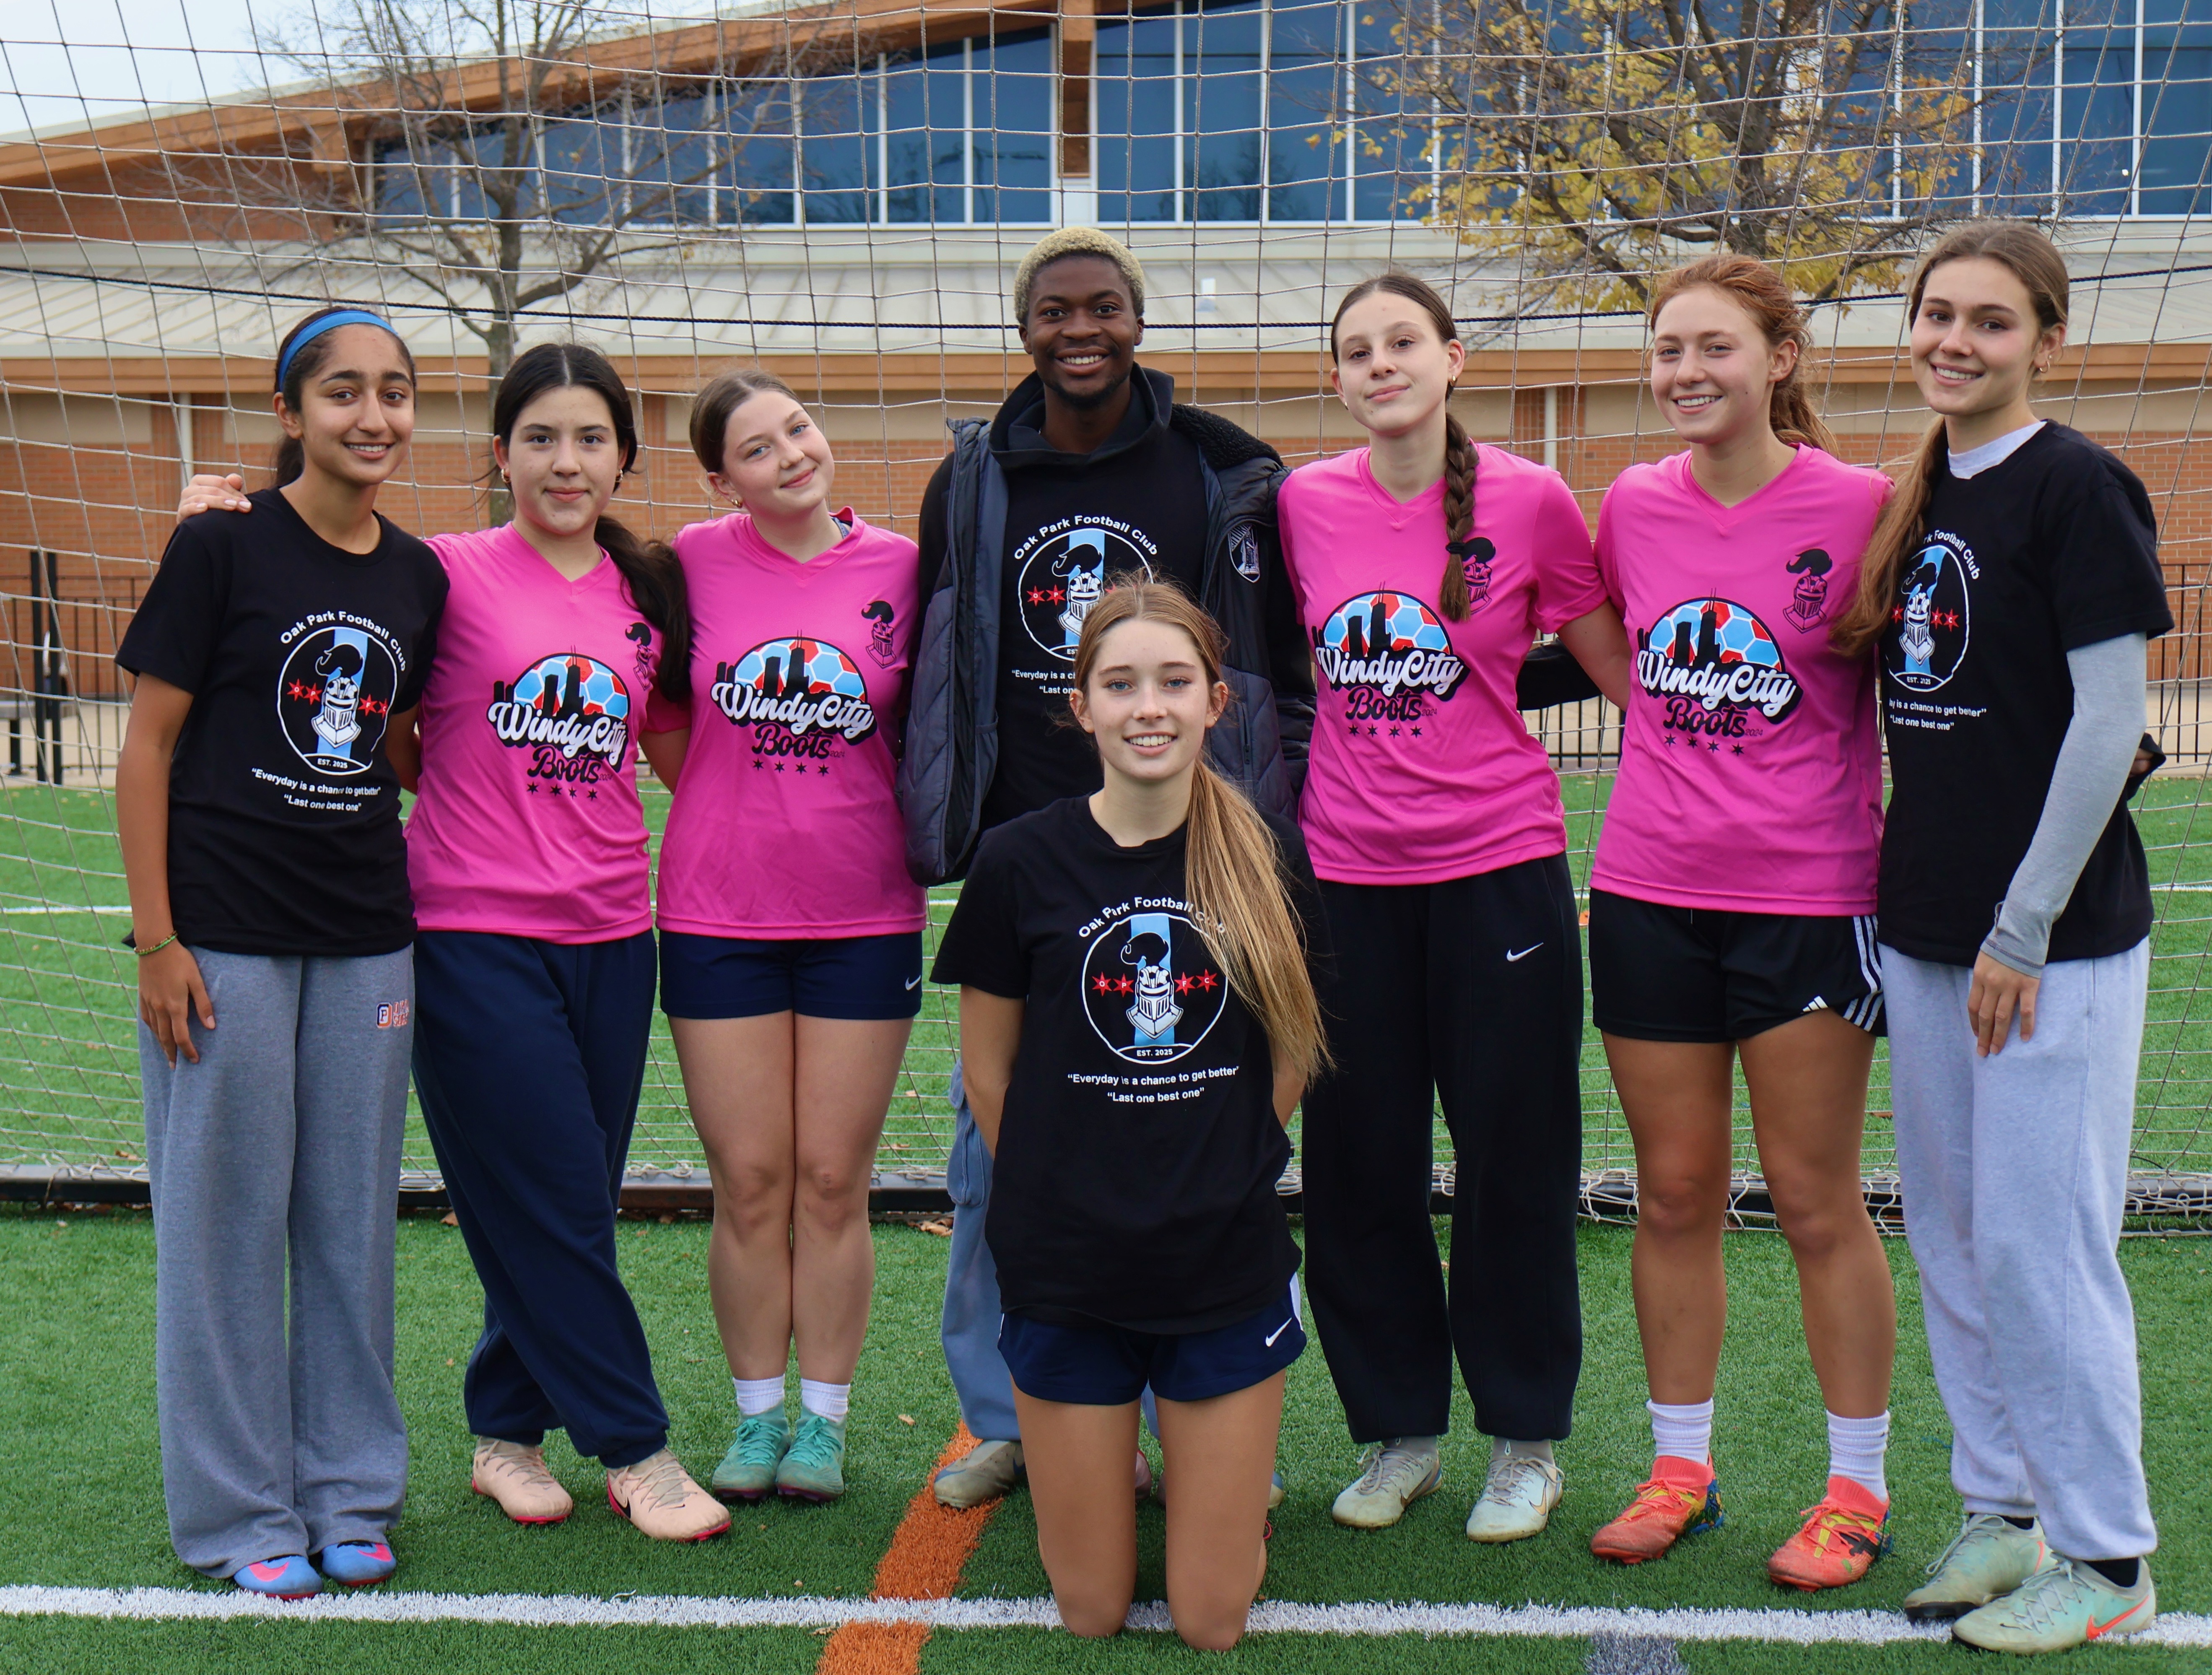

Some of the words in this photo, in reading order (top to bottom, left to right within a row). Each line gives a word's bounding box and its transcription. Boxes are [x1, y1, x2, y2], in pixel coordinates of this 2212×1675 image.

[1014, 535, 1038, 560] Oak
[1039, 518, 1071, 537] Park
[1075, 515, 1130, 533] Football
[1132, 529, 1158, 556] Club
[1923, 534, 1933, 544] rk
[1934, 530, 1966, 552] Football
[1963, 549, 1981, 580] Club
[280, 621, 306, 644] Oak
[306, 610, 335, 626] Park
[338, 610, 389, 640] Football
[390, 638, 406, 671] Club
[1012, 670, 1048, 680] “Everyday
[1039, 685, 1061, 694] “Last
[1346, 686, 1423, 722] Boots
[1663, 696, 1748, 738] Boots
[1896, 699, 1902, 709] is
[1910, 701, 1934, 713] chance
[1935, 705, 1942, 714] to
[1944, 706, 1957, 716] get
[1921, 719, 1936, 729] best
[1937, 722, 1955, 730] one”
[751, 723, 834, 760] Boots
[317, 758, 332, 767] EST.
[333, 760, 348, 769] 2025
[527, 745, 603, 784] Boots
[252, 767, 299, 790] “Everyday
[299, 781, 307, 790] is
[345, 786, 353, 795] to
[354, 787, 364, 797] get
[284, 793, 309, 808] “Last
[326, 801, 345, 810] best
[1078, 917, 1105, 938] Oak
[1102, 902, 1131, 919] Park
[1134, 896, 1194, 912] Football
[1195, 911, 1225, 933] Cb
[1068, 1073, 1119, 1086] “Everyday
[1121, 1075, 1129, 1085] is
[1141, 1075, 1176, 1086] chance
[1179, 1073, 1189, 1082] to
[1192, 1070, 1206, 1082] get
[1208, 1065, 1240, 1078] better”
[1107, 1092, 1133, 1102] “Last
[1136, 1093, 1155, 1103] one
[1158, 1090, 1180, 1101] best
[1182, 1087, 1205, 1098] one”
